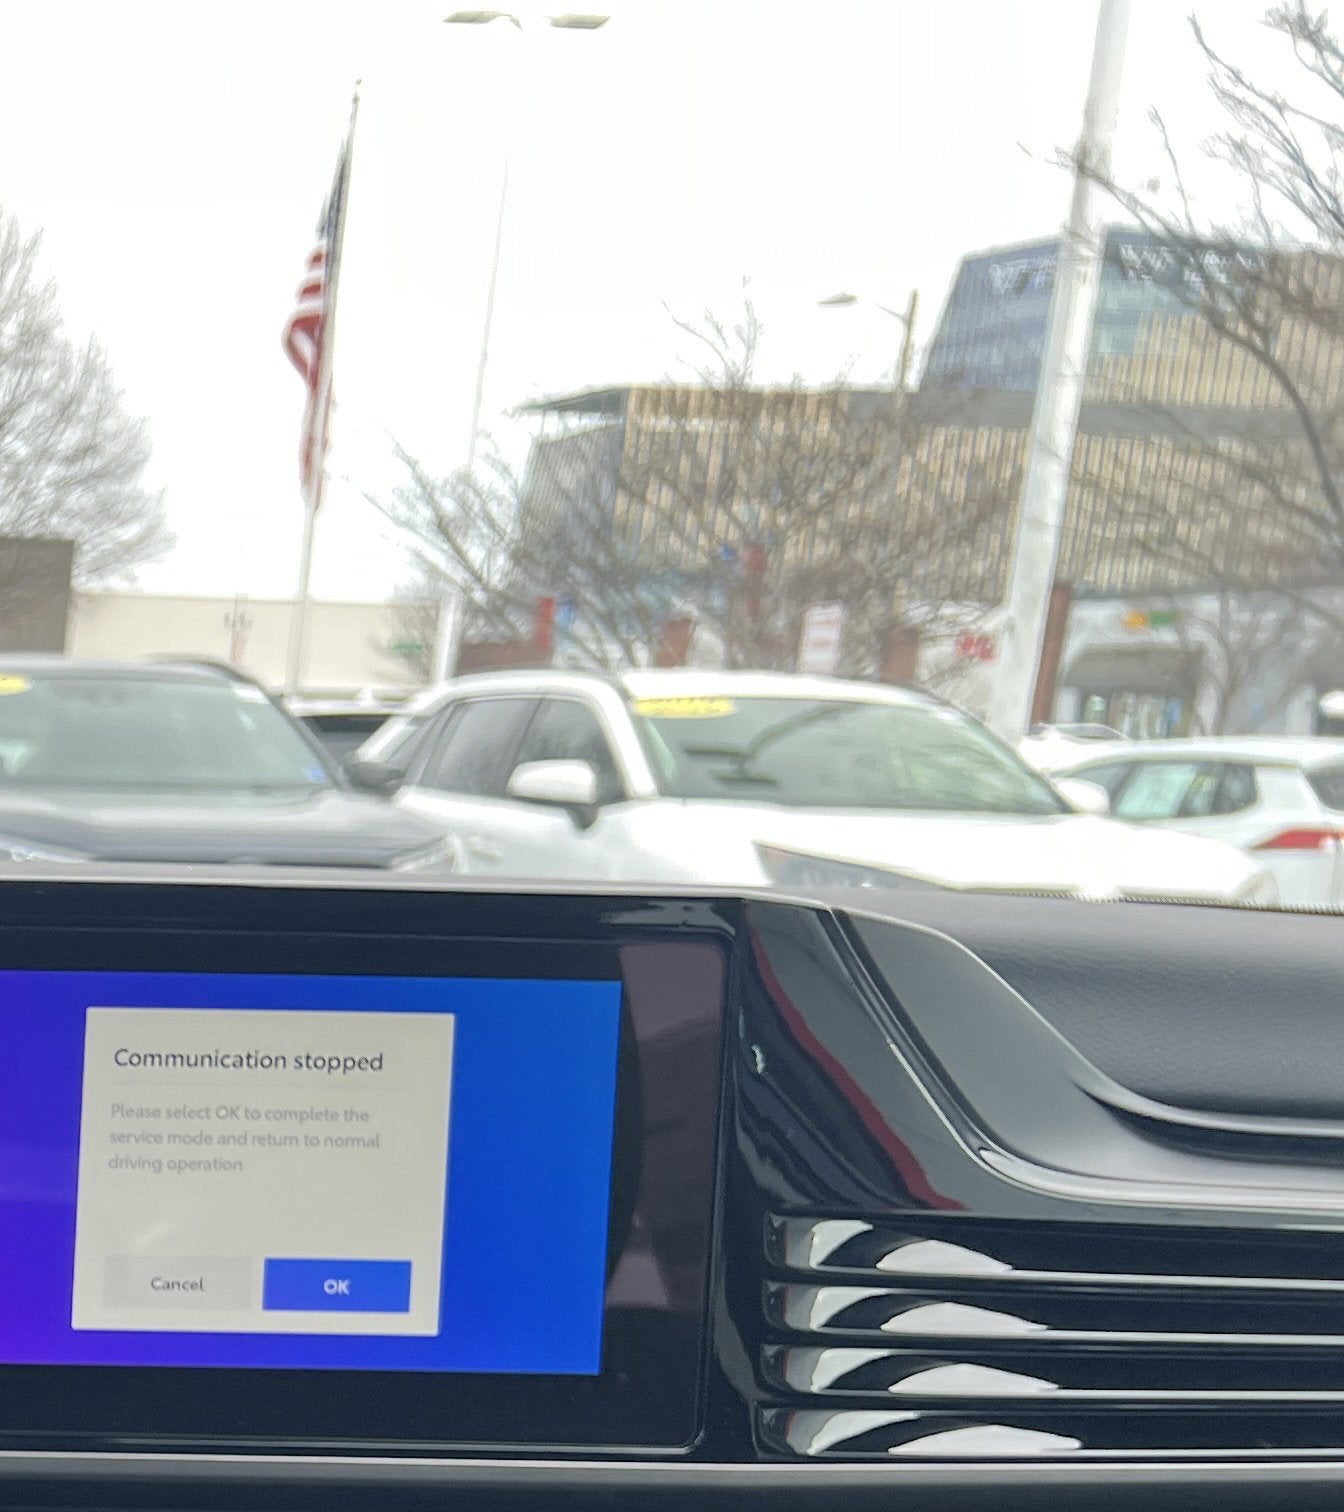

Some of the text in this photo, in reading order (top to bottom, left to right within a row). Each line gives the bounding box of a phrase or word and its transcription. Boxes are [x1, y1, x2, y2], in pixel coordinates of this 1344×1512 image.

[113, 1048, 384, 1076] Communication stopped
[110, 1103, 370, 1126] Please select OK to complete the
[109, 1131, 381, 1149] service mode and return to normal
[108, 1154, 243, 1175] driving operation
[150, 1276, 351, 1295] Cancel OK
